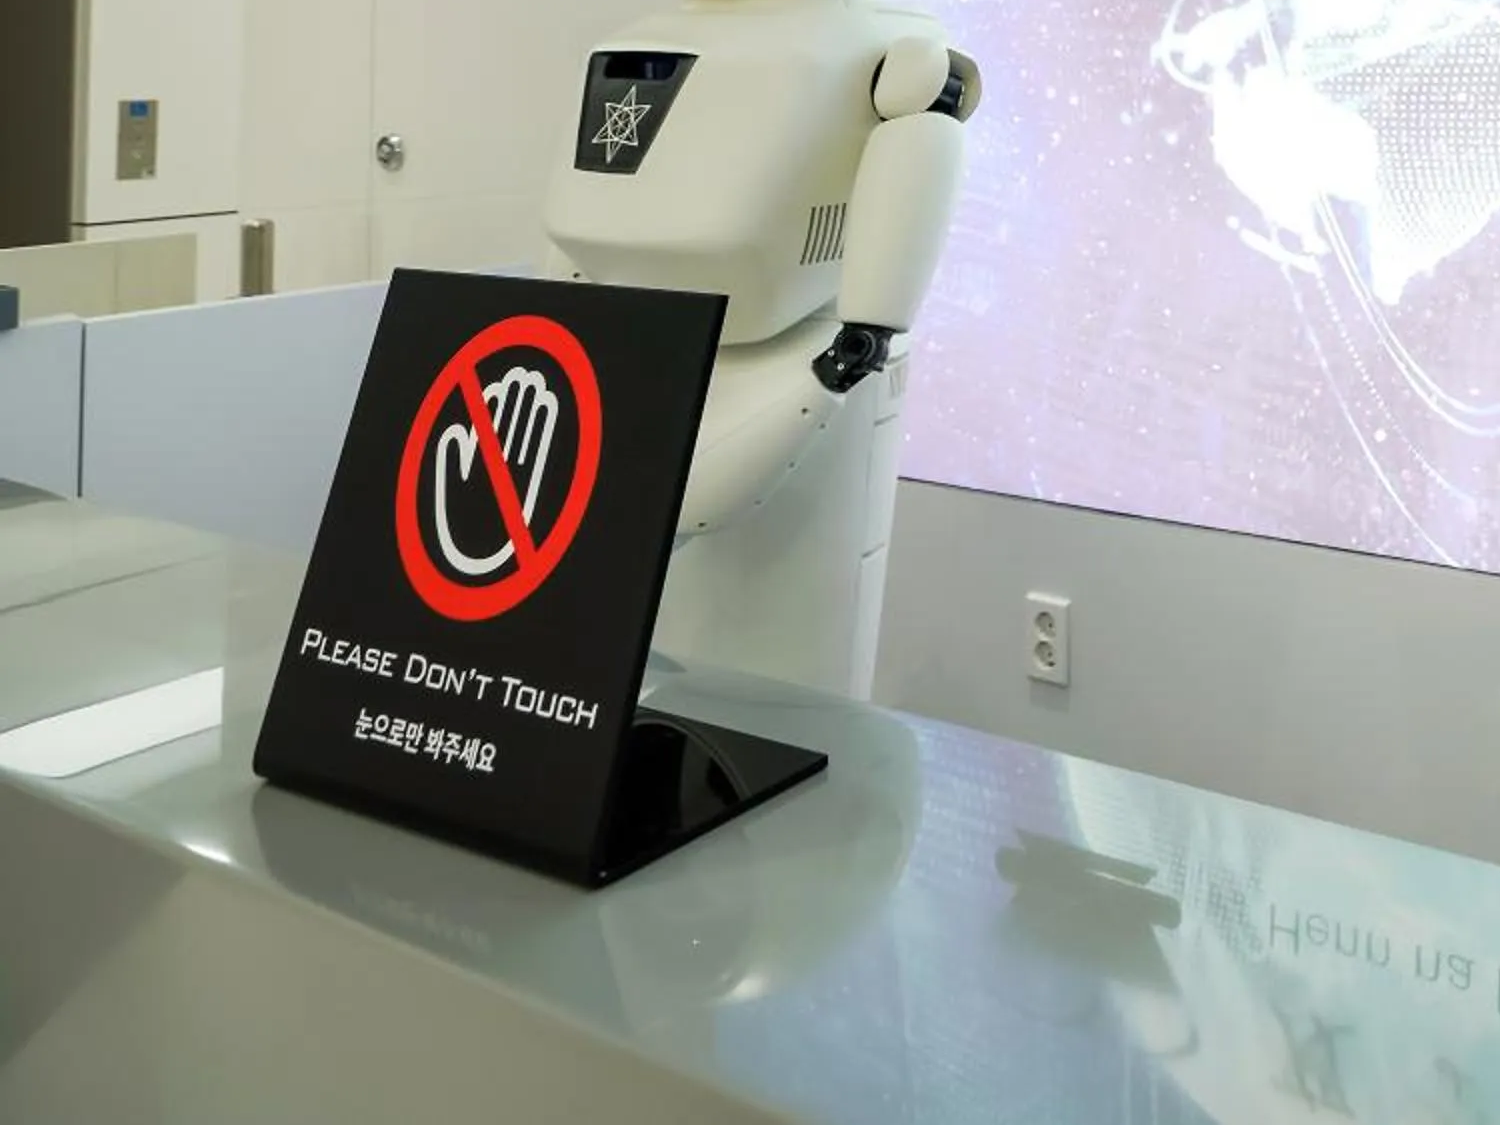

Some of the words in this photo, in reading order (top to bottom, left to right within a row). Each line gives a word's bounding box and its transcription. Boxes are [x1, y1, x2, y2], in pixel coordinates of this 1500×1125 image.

[300, 628, 398, 677] PLEASE
[403, 653, 493, 700] DON'T
[501, 676, 599, 729] TOUCH
[354, 707, 425, 754] 눈으로만
[423, 728, 497, 773] 봐주세요
